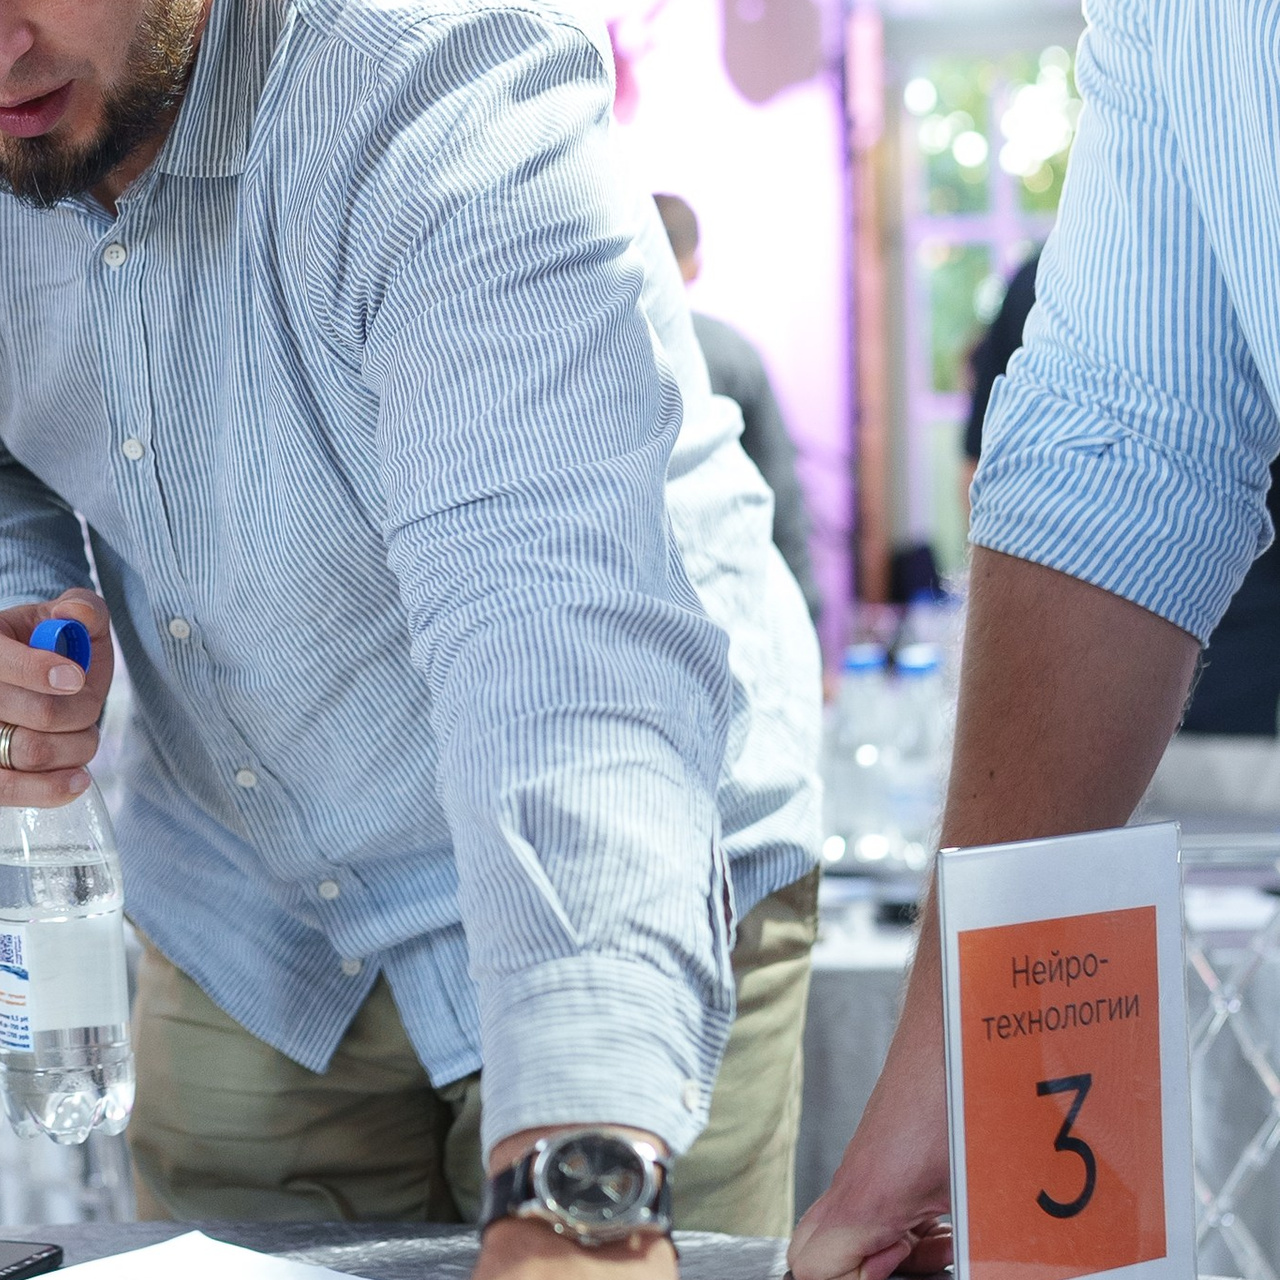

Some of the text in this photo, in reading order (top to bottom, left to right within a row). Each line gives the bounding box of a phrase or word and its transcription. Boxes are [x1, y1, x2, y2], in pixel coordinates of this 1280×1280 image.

[1011, 949, 1109, 988] Нейро-
[981, 994, 1140, 1041] технологии
[1035, 1073, 1098, 1219] 3
